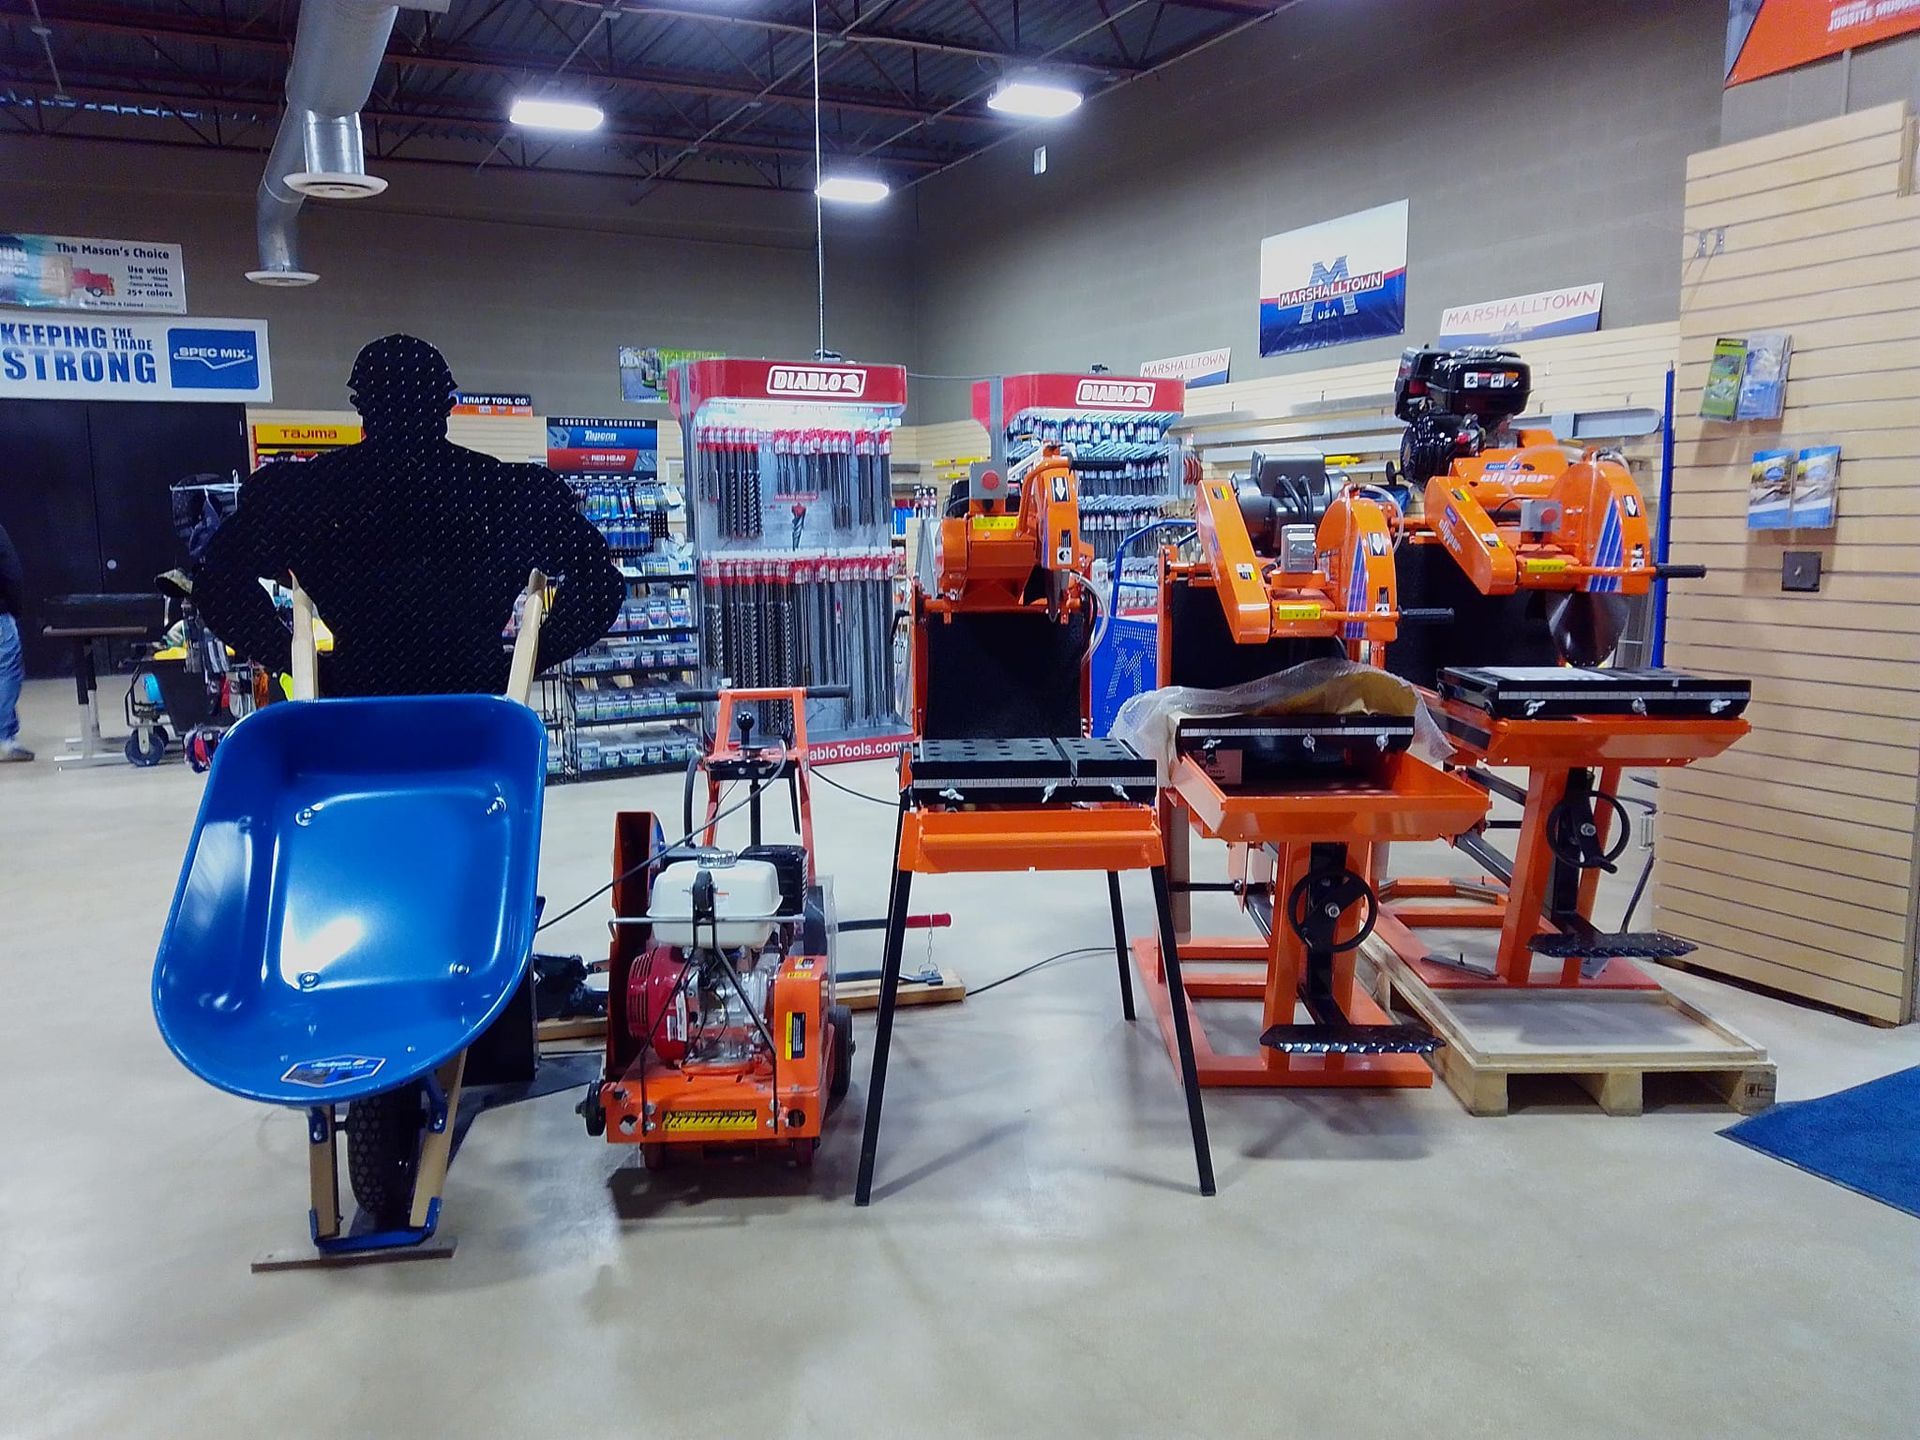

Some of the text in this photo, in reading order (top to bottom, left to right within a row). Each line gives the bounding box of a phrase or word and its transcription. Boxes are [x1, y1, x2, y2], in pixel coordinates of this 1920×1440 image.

[55, 243, 170, 260] The Mason's Choice
[127, 265, 168, 275] Use with
[146, 289, 173, 297] colors
[1280, 272, 1382, 306] MARSHALLTOWN
[1317, 309, 1338, 320] USA
[1446, 289, 1597, 327] MARSHALLTOWN
[0, 323, 108, 349] KEEPING
[112, 328, 133, 339] THE
[113, 338, 153, 351] TRADE
[179, 346, 246, 359] SPEC MIX
[3, 348, 157, 384] STRONG
[1142, 352, 1227, 377] MARSHALLTOWN
[774, 371, 842, 391] DIABLO
[1081, 385, 1136, 402] DIABLO
[462, 396, 490, 404] KRAFT
[491, 397, 513, 405] TOOL
[559, 419, 646, 428] CONCRETE ANCHORING
[591, 454, 606, 462] RED
